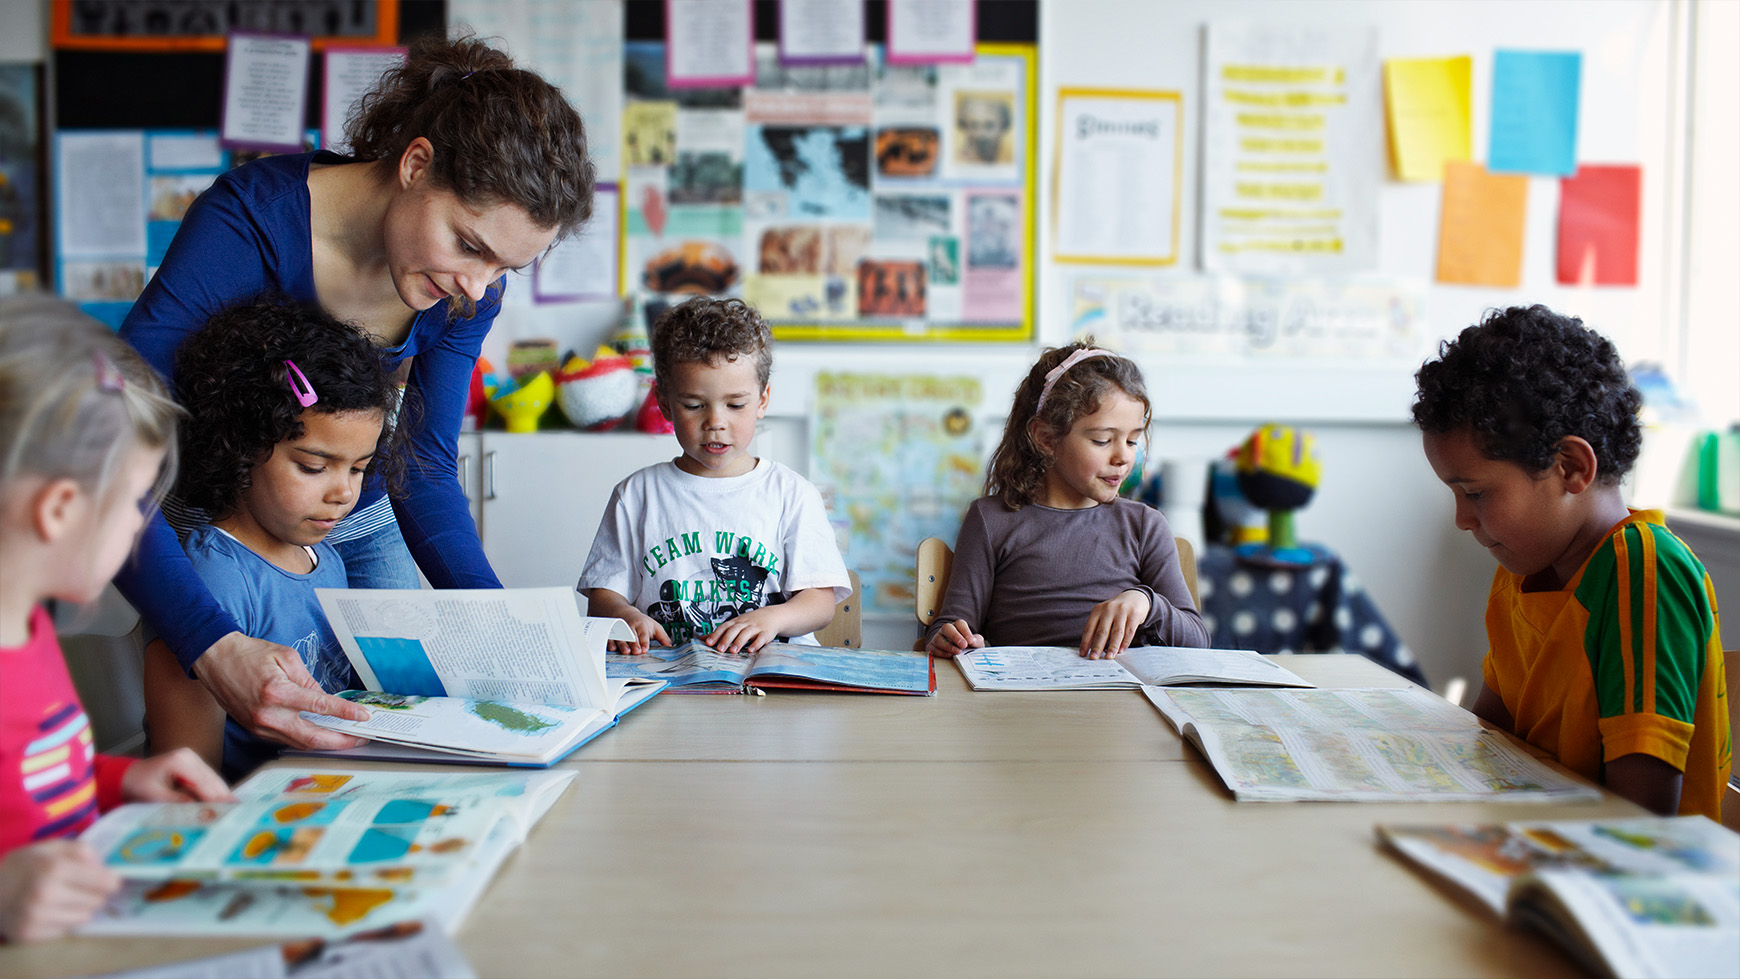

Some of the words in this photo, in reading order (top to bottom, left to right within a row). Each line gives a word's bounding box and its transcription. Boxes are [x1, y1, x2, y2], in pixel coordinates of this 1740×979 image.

[643, 531, 702, 577] TEAM
[715, 531, 779, 575] WORK
[671, 580, 751, 602] MAKES
